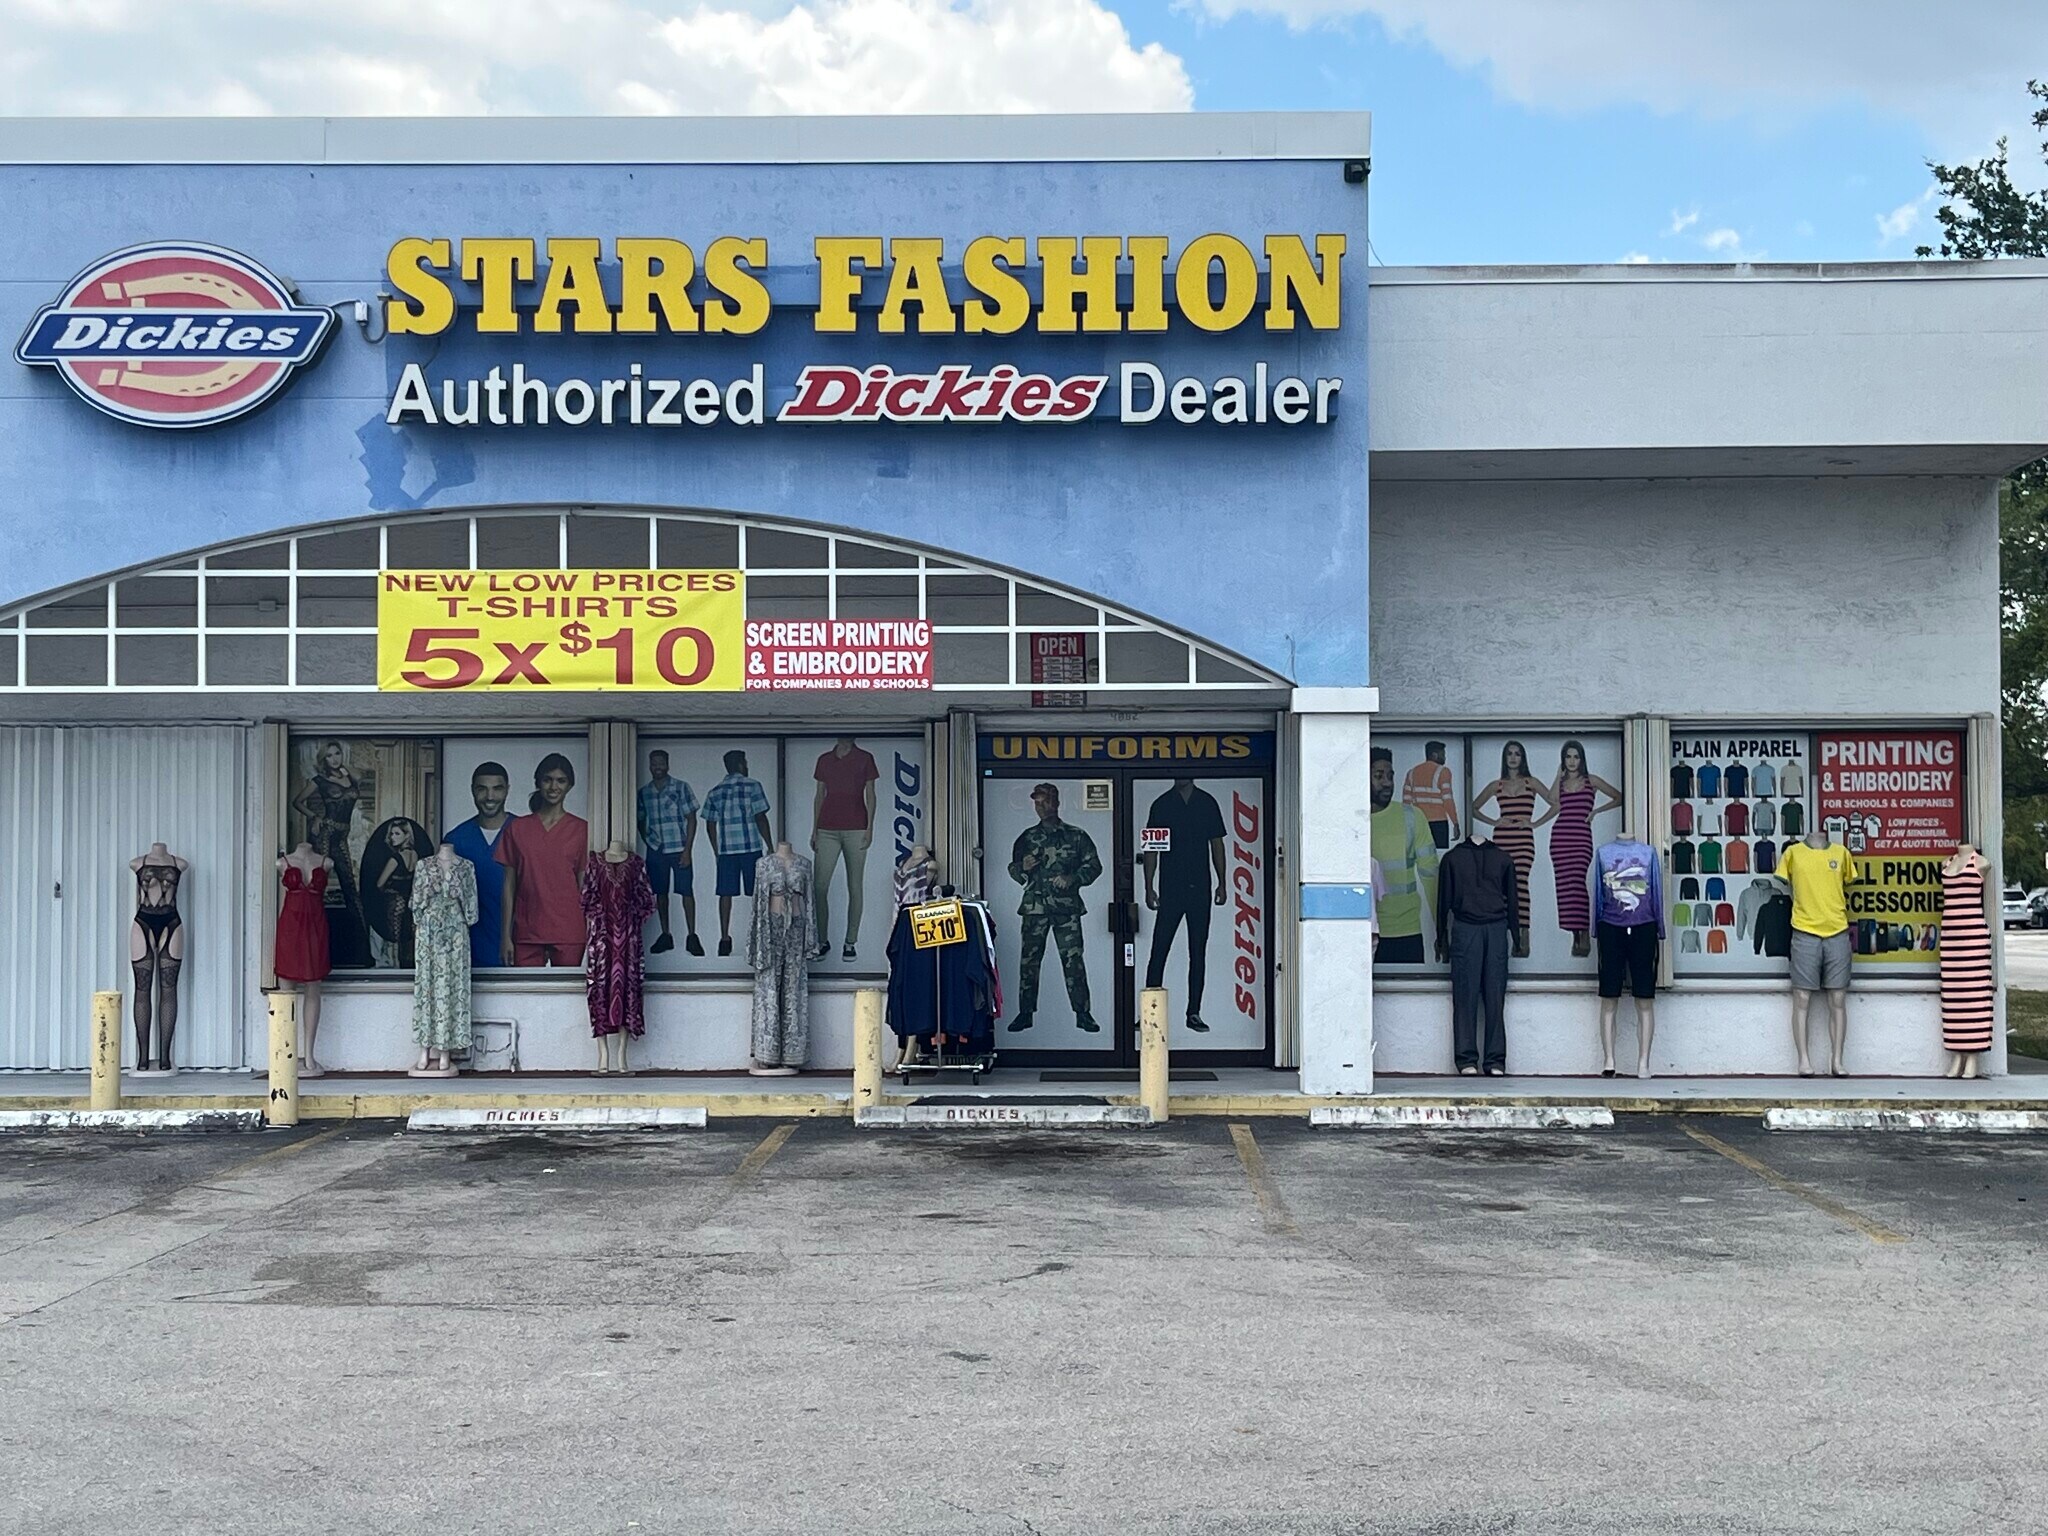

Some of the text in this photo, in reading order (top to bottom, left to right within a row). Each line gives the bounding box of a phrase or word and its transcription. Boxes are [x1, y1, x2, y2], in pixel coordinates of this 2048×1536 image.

[387, 233, 1346, 335] STARS FASHION
[52, 317, 300, 350] Dickies
[387, 361, 1343, 425] Authorized Dickies Dealer
[386, 574, 736, 592] NEW LOW PRICES
[437, 597, 678, 618] T-SHIRTS
[746, 622, 929, 647] SCREEN PRINTING
[1038, 636, 1078, 655] OPEN
[748, 651, 928, 675] & EMBROIDERY
[746, 679, 929, 689] FOR COMPANIES AND SCHOOLS
[992, 736, 1250, 759] UNIFORMS
[1672, 740, 1802, 758] PLAIN APPAREL
[1822, 740, 1954, 766] PRINTING
[1822, 771, 1954, 792] & EMBROIDERY
[1823, 798, 1954, 808] FOR SCHOOLS & COMPANIES
[1886, 829, 1905, 837] LOW
[1888, 818, 1906, 827] LOW
[1908, 818, 1939, 827] PRICES
[1141, 829, 1168, 841] STOP
[1874, 839, 1890, 848] GET
[1893, 839, 1900, 848] A
[1901, 839, 1931, 848] QUOTE
[1883, 862, 1943, 885] PHON
[1233, 790, 1262, 1020] Dickies
[947, 1109, 1019, 1119] DICKIES
